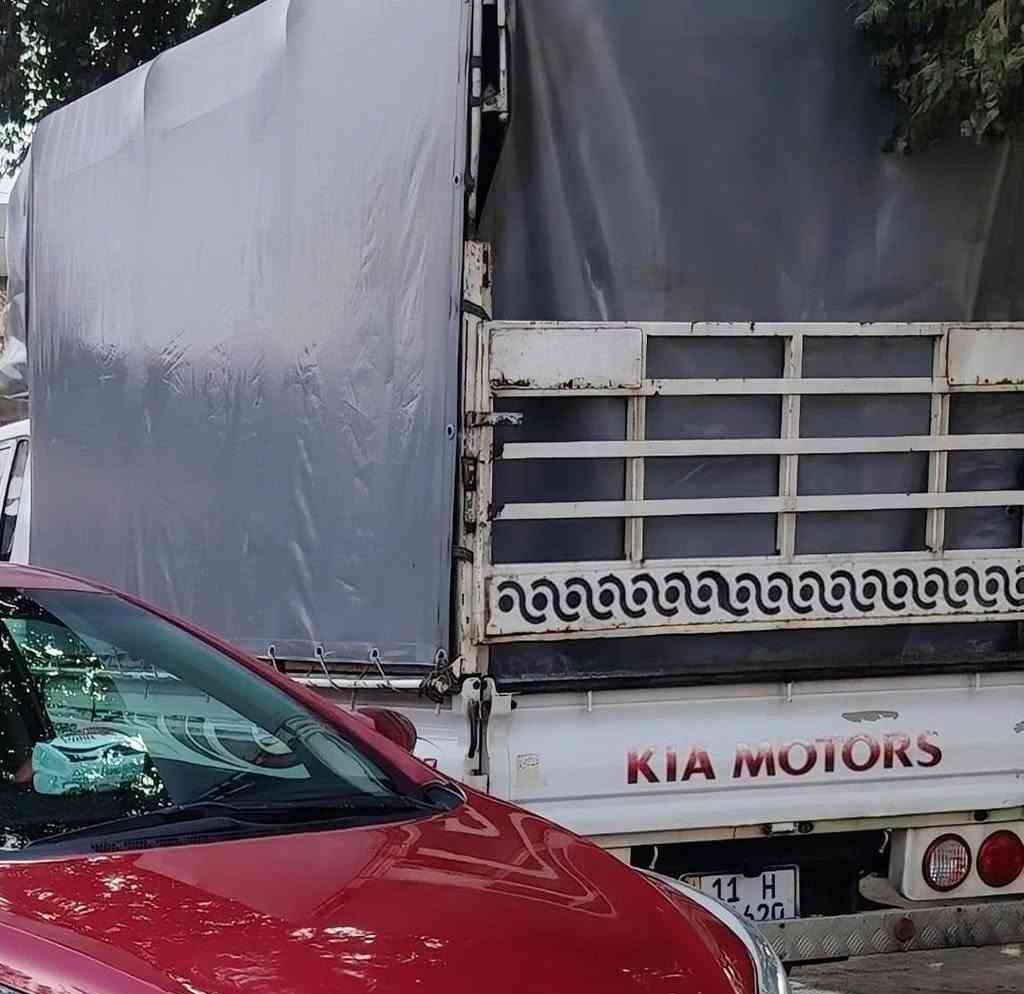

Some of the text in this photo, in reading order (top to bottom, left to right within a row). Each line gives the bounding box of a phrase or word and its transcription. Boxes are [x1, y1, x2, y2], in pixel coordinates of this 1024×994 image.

[627, 731, 943, 785] KIA MOTORS
[712, 877, 740, 903] 11
[762, 873, 776, 900] H
